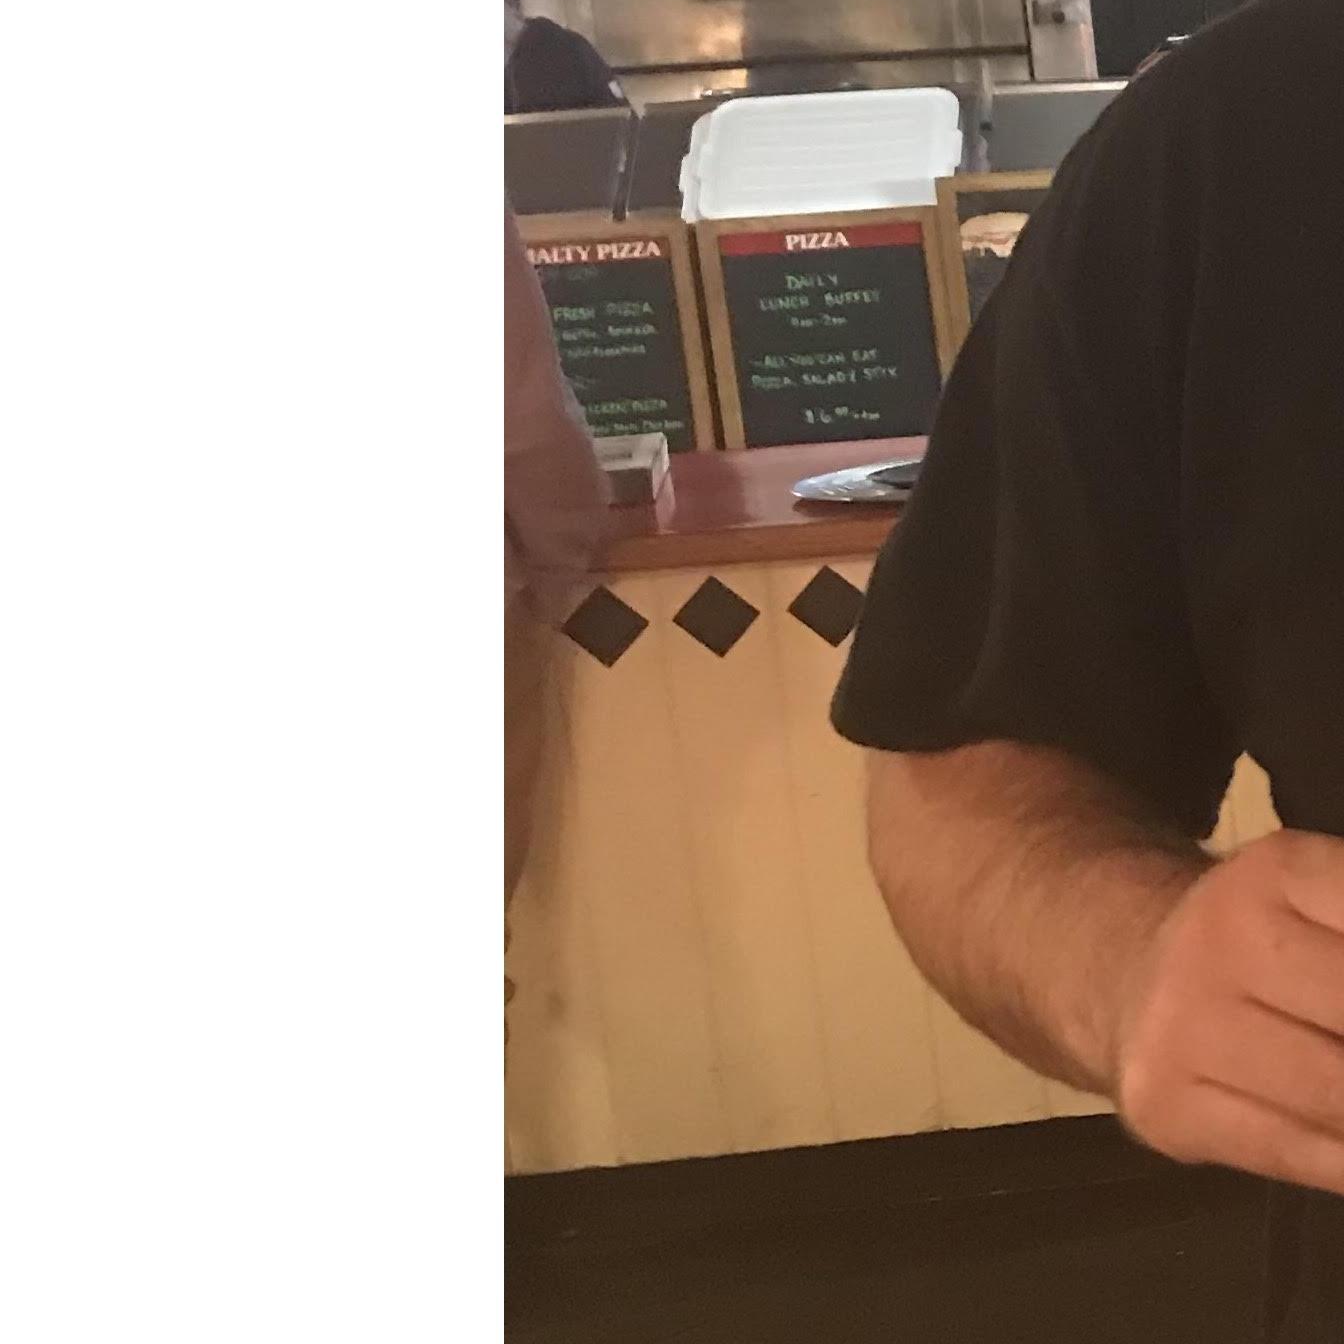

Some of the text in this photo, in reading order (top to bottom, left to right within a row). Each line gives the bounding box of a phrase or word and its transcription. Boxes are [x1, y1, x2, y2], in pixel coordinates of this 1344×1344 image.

[785, 231, 849, 250] PIZZA
[597, 241, 661, 260] PIZZA
[785, 274, 838, 289] DAILY
